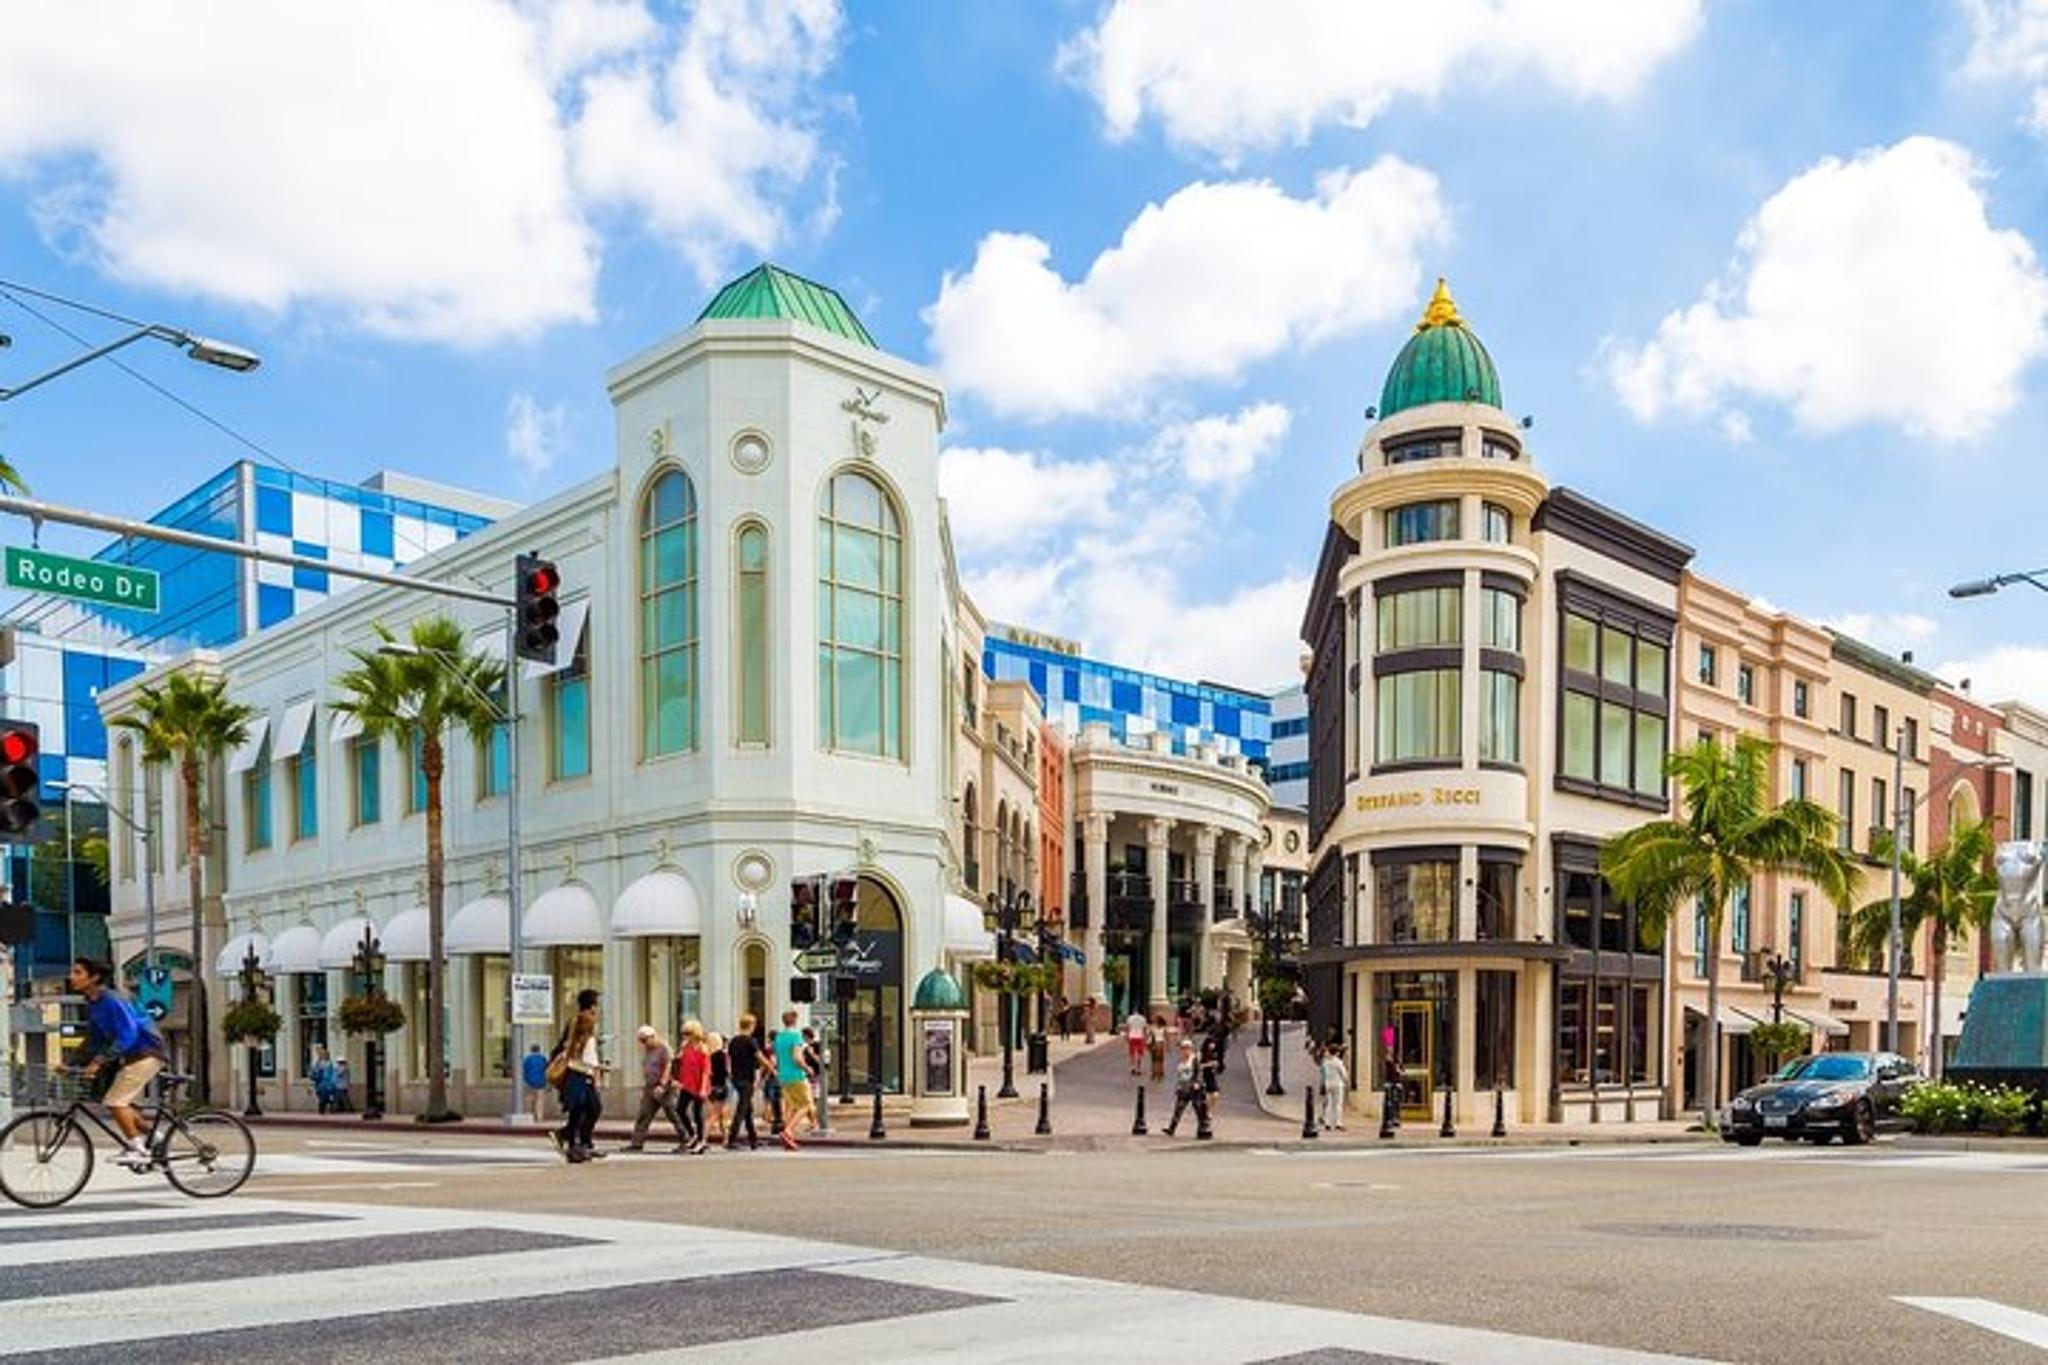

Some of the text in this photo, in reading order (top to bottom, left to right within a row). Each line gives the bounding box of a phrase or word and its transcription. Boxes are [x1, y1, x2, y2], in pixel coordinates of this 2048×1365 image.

[18, 558, 146, 599] Rodeo Dr
[1356, 787, 1480, 811] STEFANO RICCI
[150, 969, 164, 984] P
